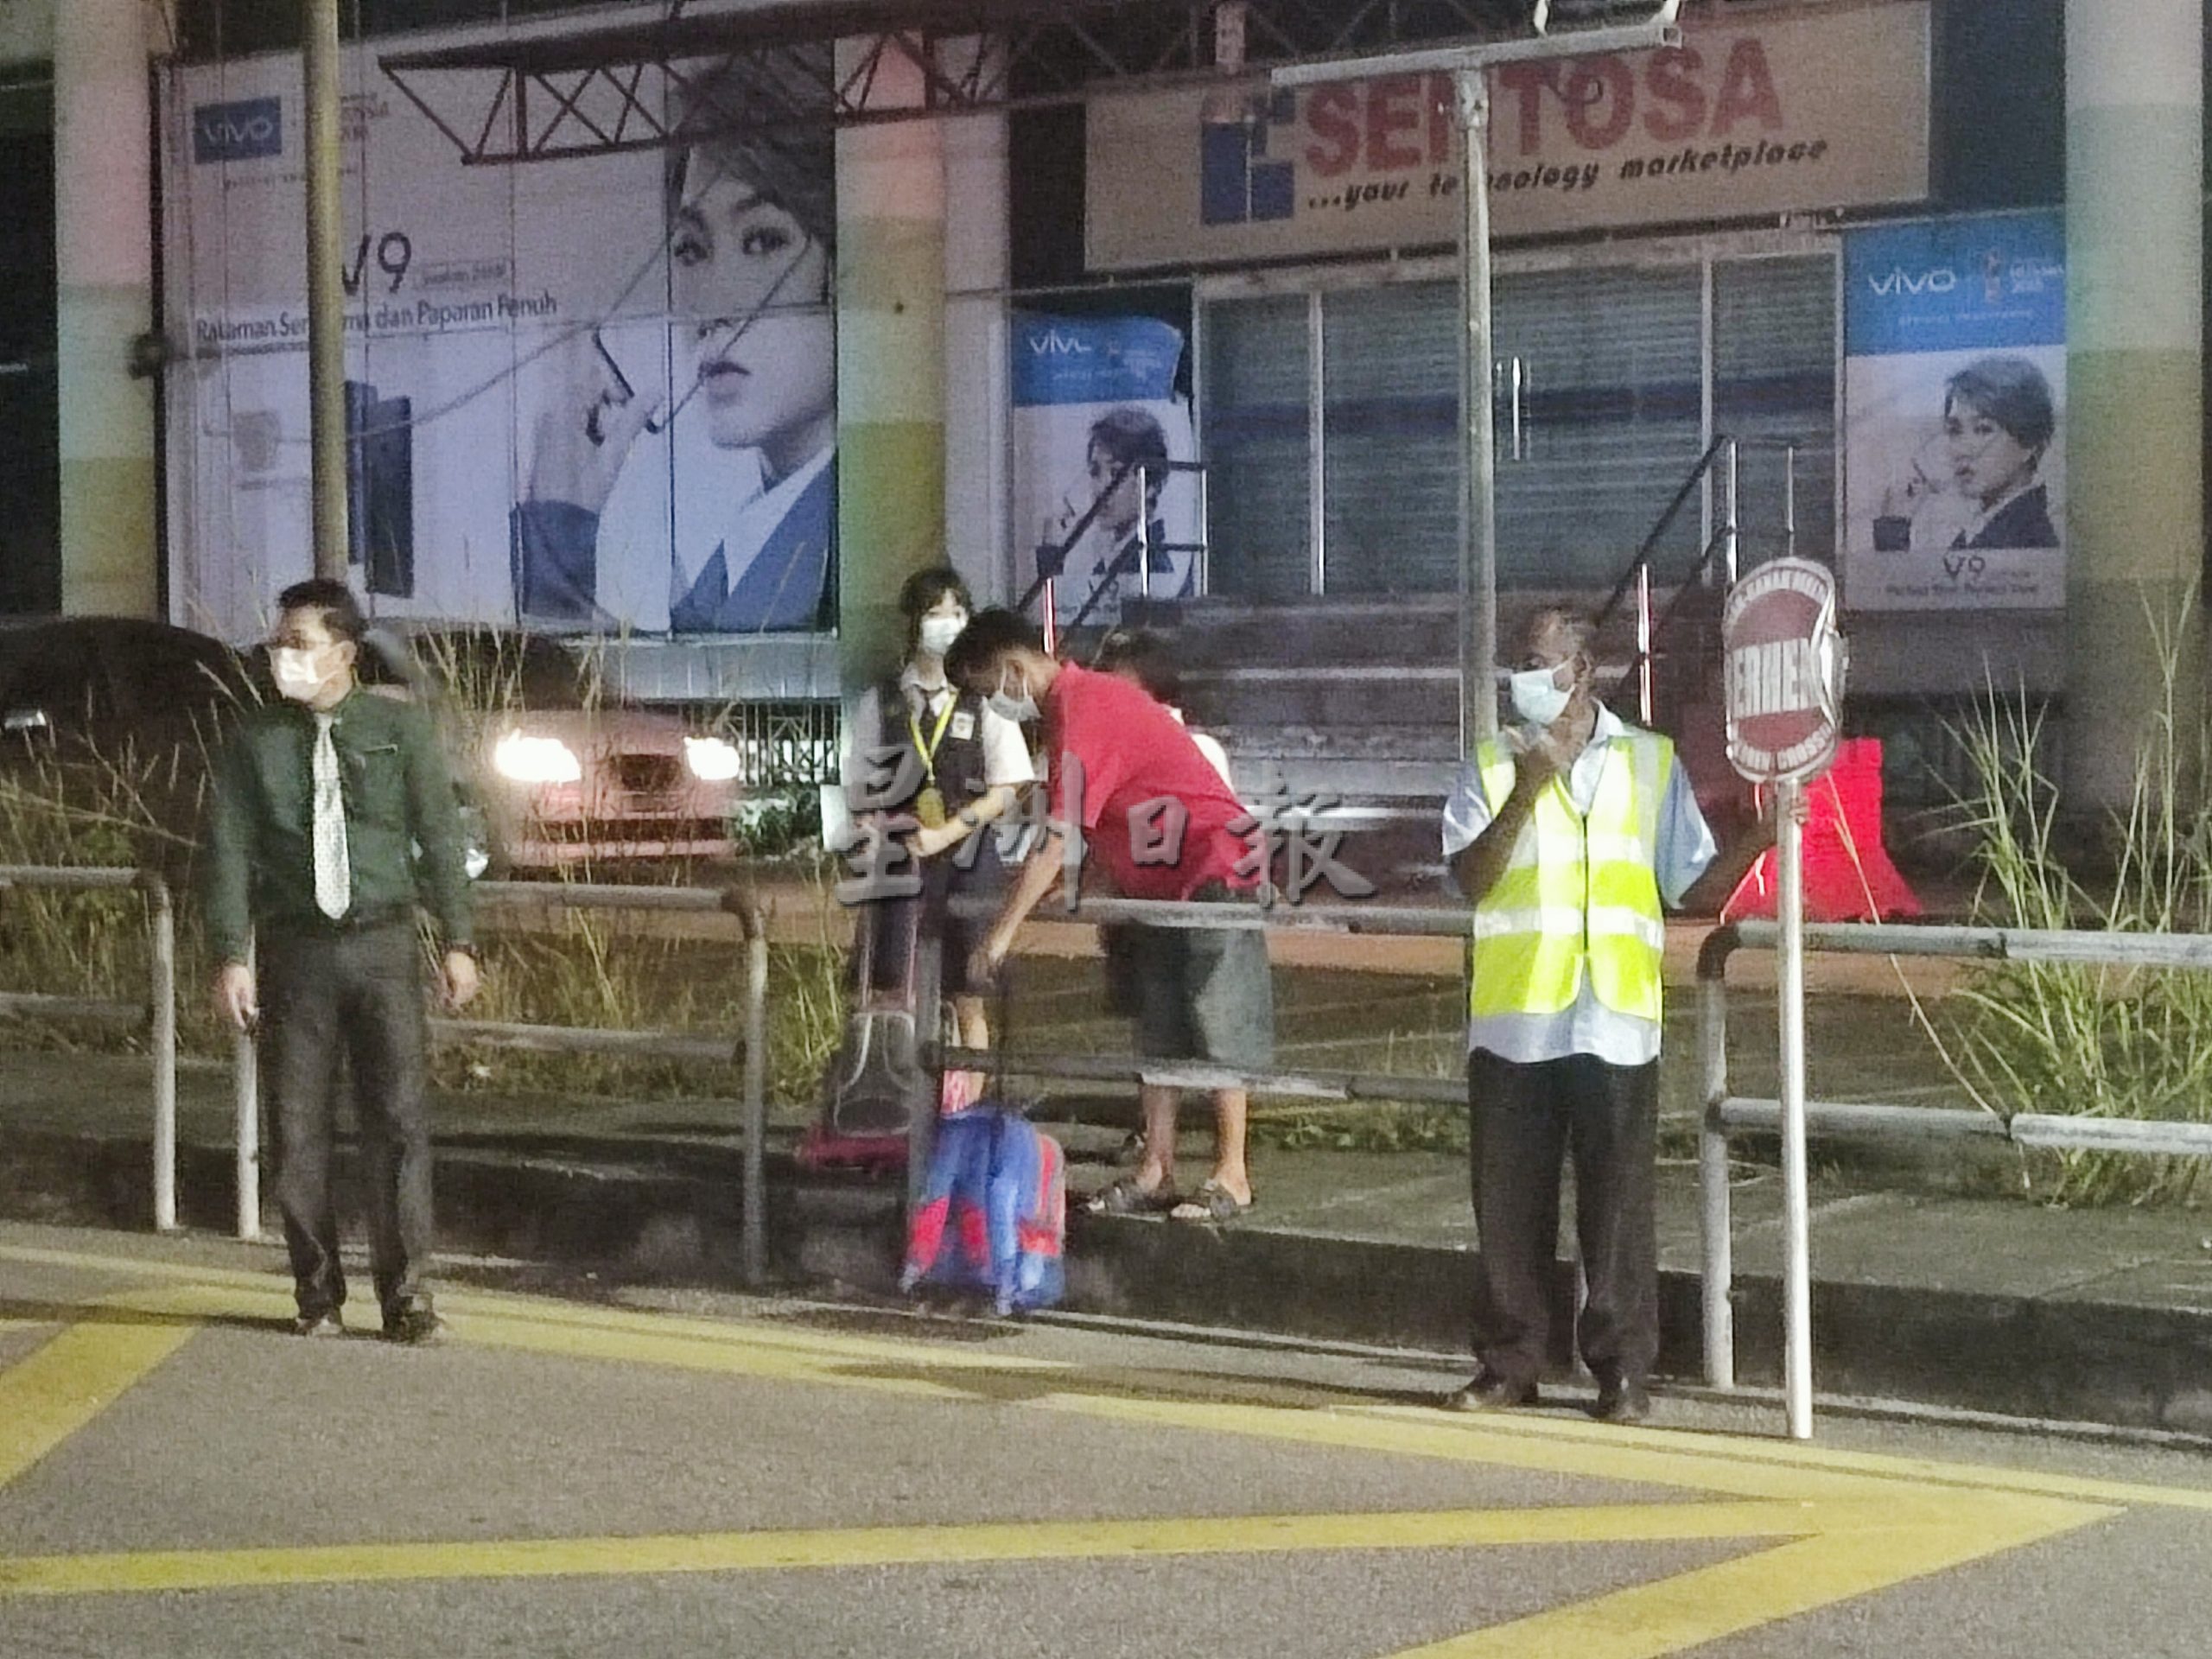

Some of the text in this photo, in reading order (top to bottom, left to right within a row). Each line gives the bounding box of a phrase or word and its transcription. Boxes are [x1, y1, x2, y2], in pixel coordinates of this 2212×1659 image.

[1429, 162, 1600, 197] tenology
[1620, 138, 1828, 180] marketplace
[1867, 266, 1957, 296] vivo
